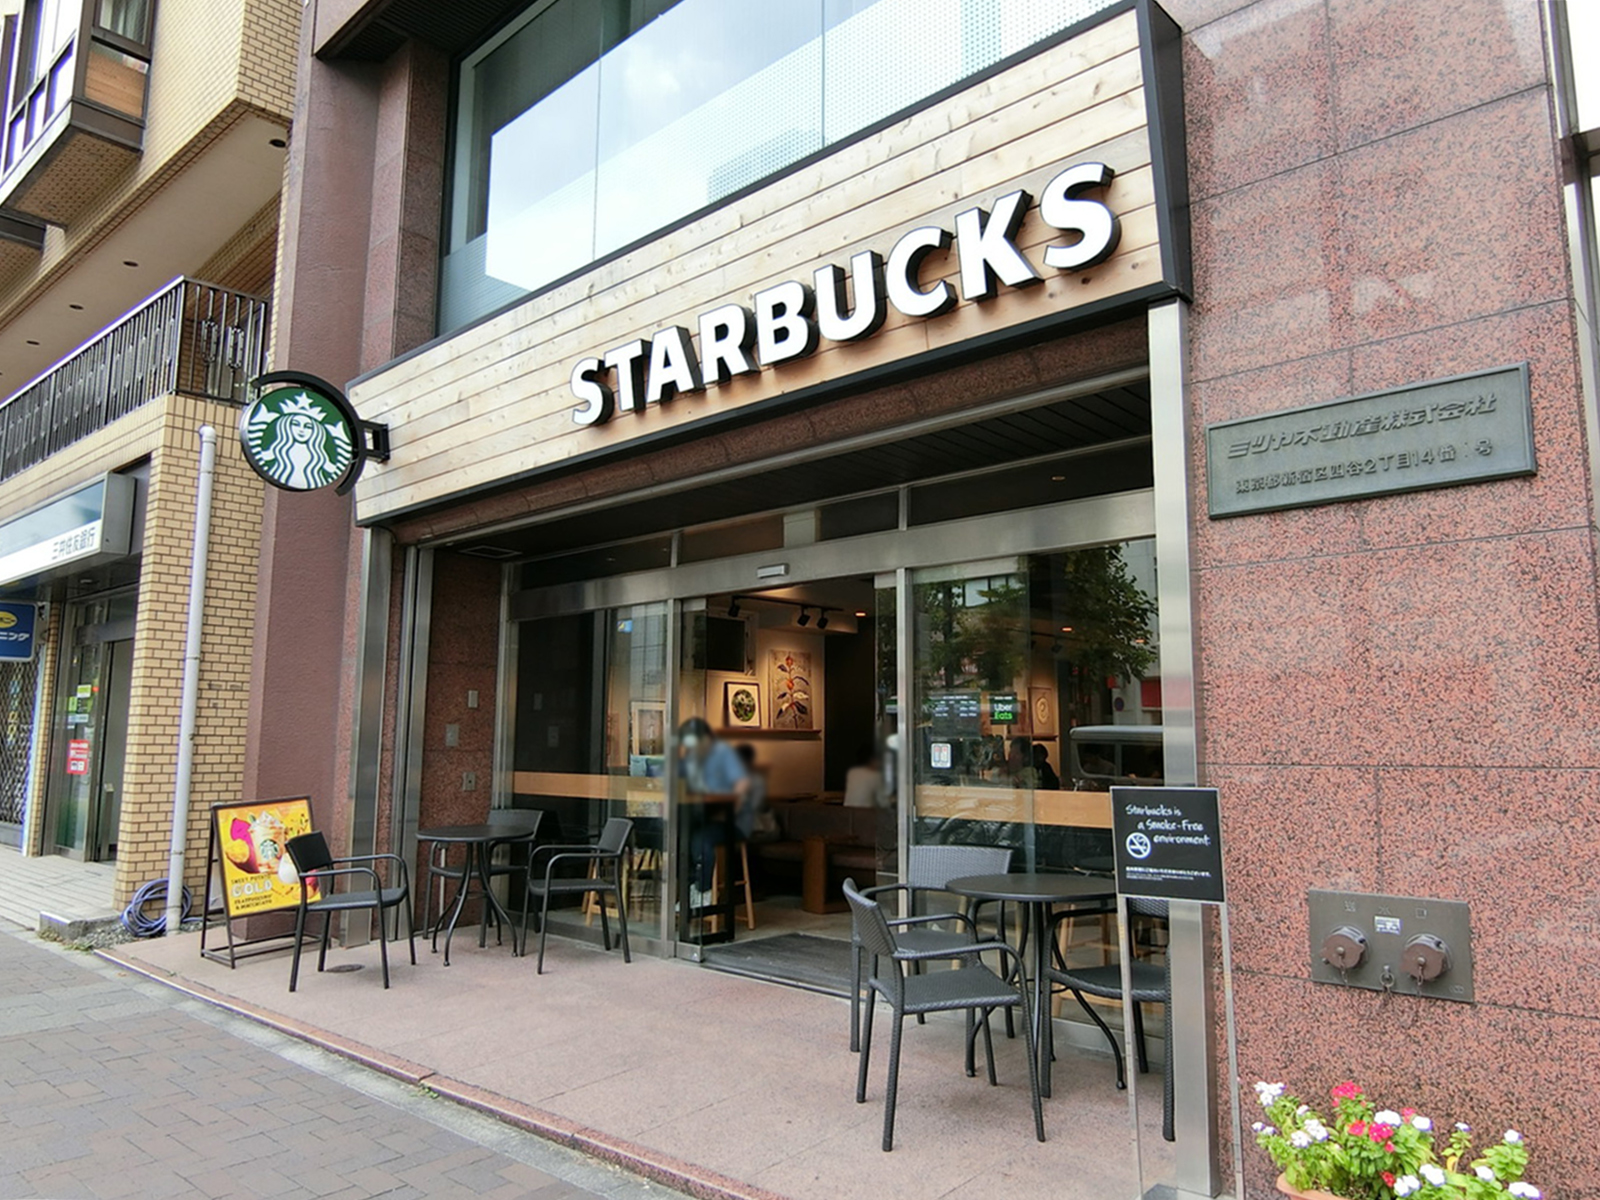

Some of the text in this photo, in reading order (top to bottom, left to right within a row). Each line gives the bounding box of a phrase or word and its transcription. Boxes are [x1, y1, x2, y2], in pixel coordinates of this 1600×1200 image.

[570, 161, 1121, 427] STARBUCKS
[1235, 438, 1493, 494] 東京都新宿区四谷2丁目14番号
[994, 703, 1013, 712] Uber
[994, 711, 1013, 720] Eats
[1125, 804, 1182, 817] Starbucks is
[1137, 821, 1145, 830] a
[232, 880, 272, 897] GOLD
